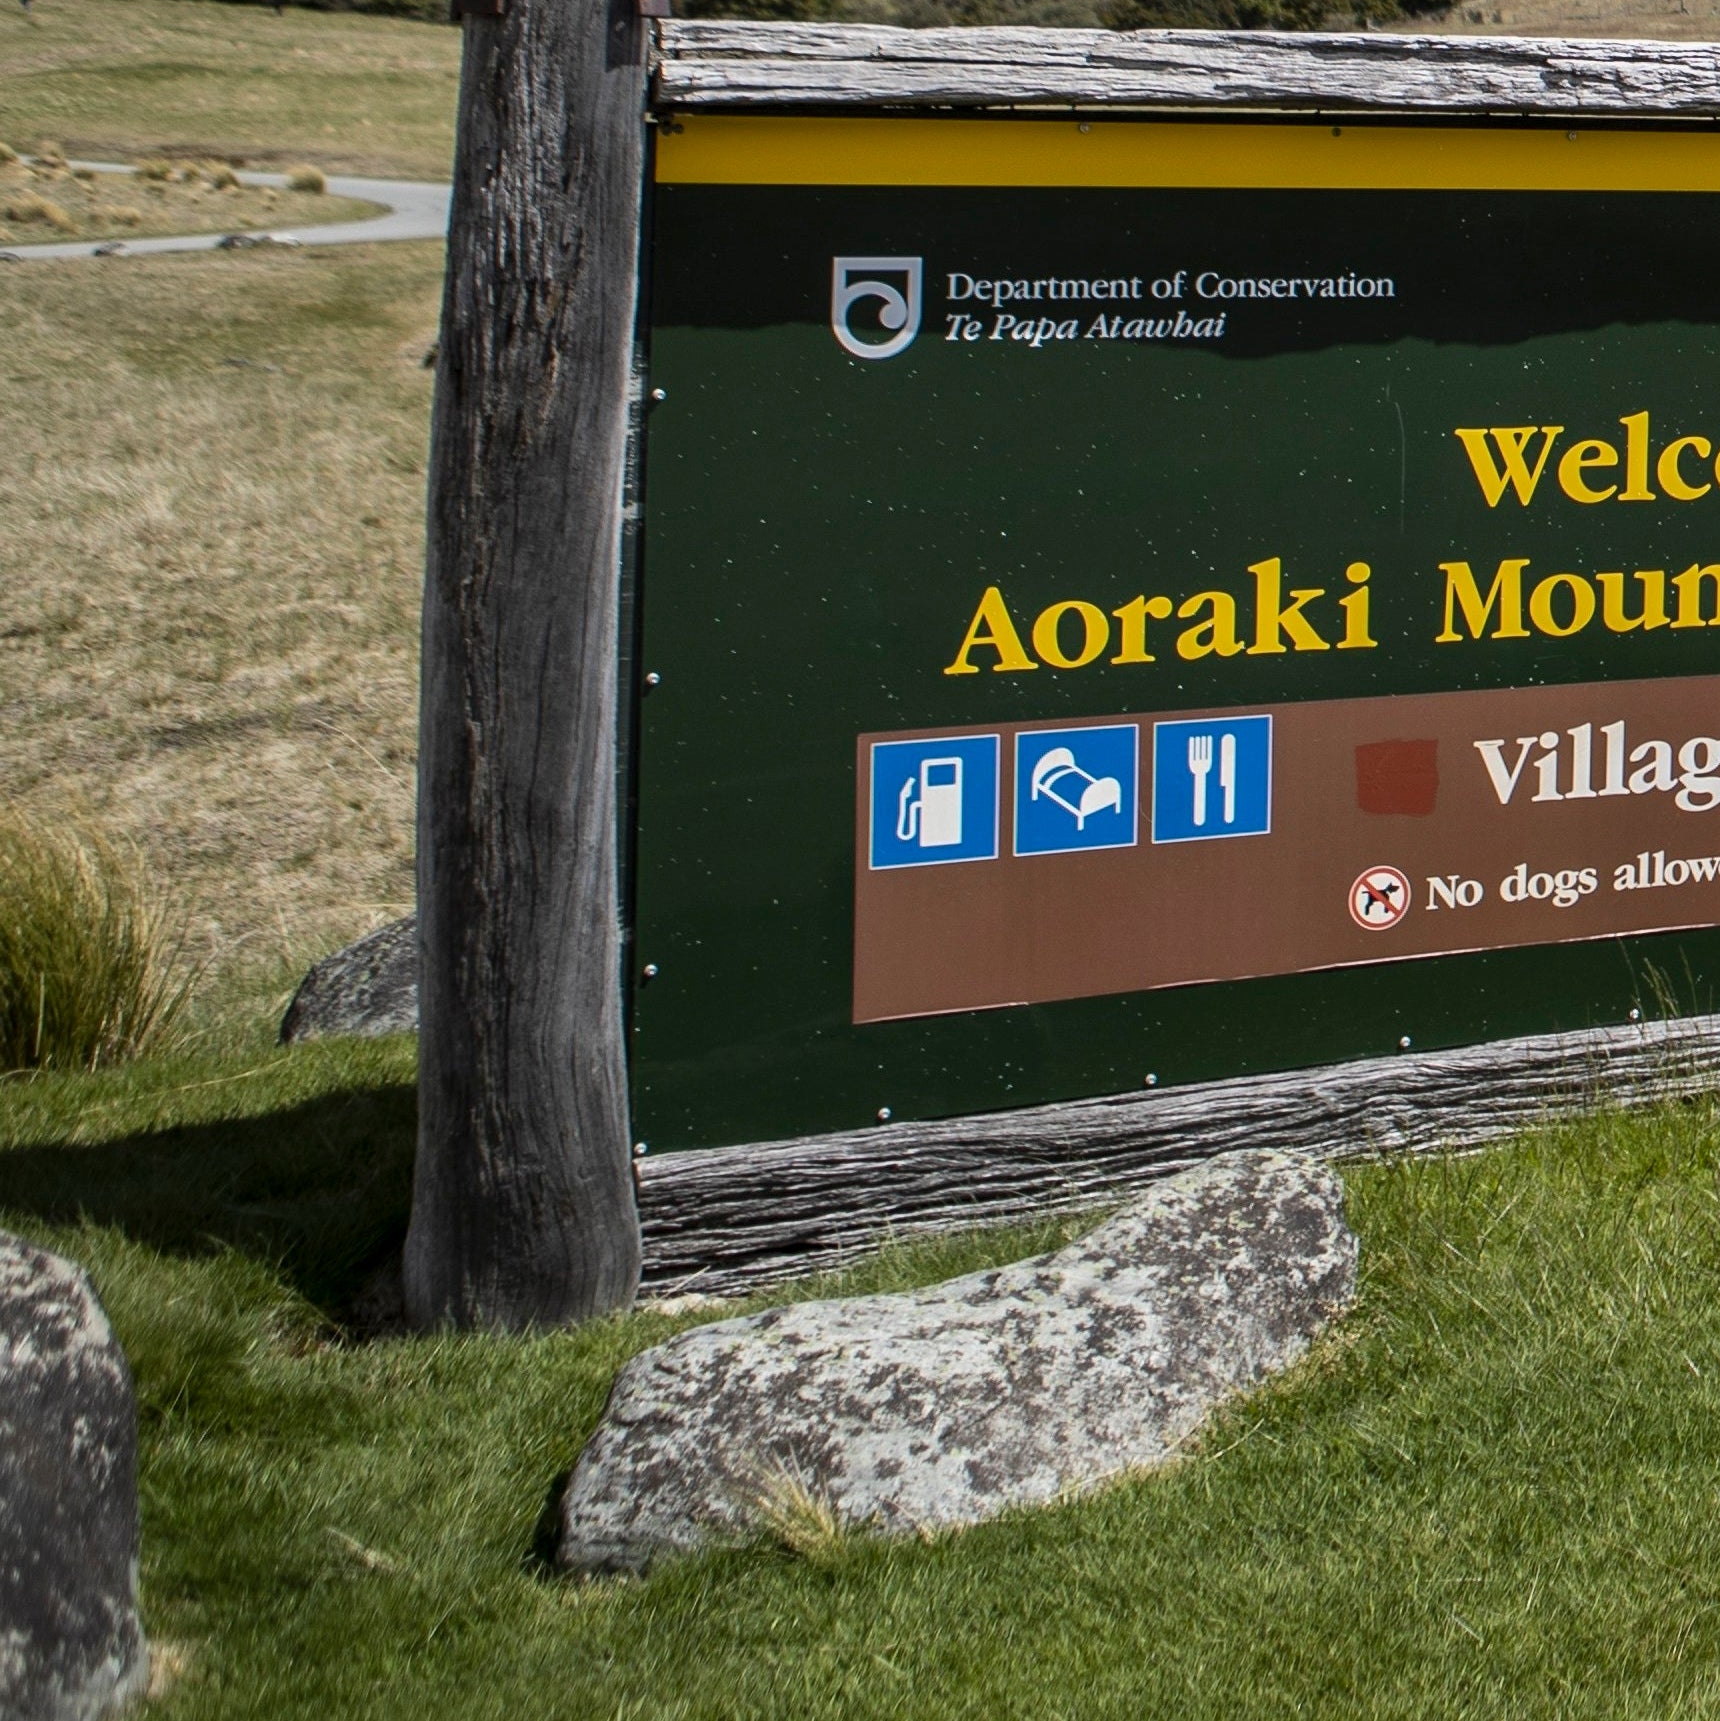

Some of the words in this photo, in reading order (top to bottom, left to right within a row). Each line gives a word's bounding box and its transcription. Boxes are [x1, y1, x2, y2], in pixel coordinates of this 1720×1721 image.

[947, 274, 1142, 307] Department
[1152, 271, 1186, 298] of
[1196, 273, 1394, 298] Conservation
[945, 314, 981, 341] Te
[990, 315, 1078, 347] Papa
[1085, 311, 1226, 338] Atawhai
[944, 557, 1375, 674] Aoraki
[1426, 875, 1483, 909] No
[1501, 864, 1597, 906] dogs
